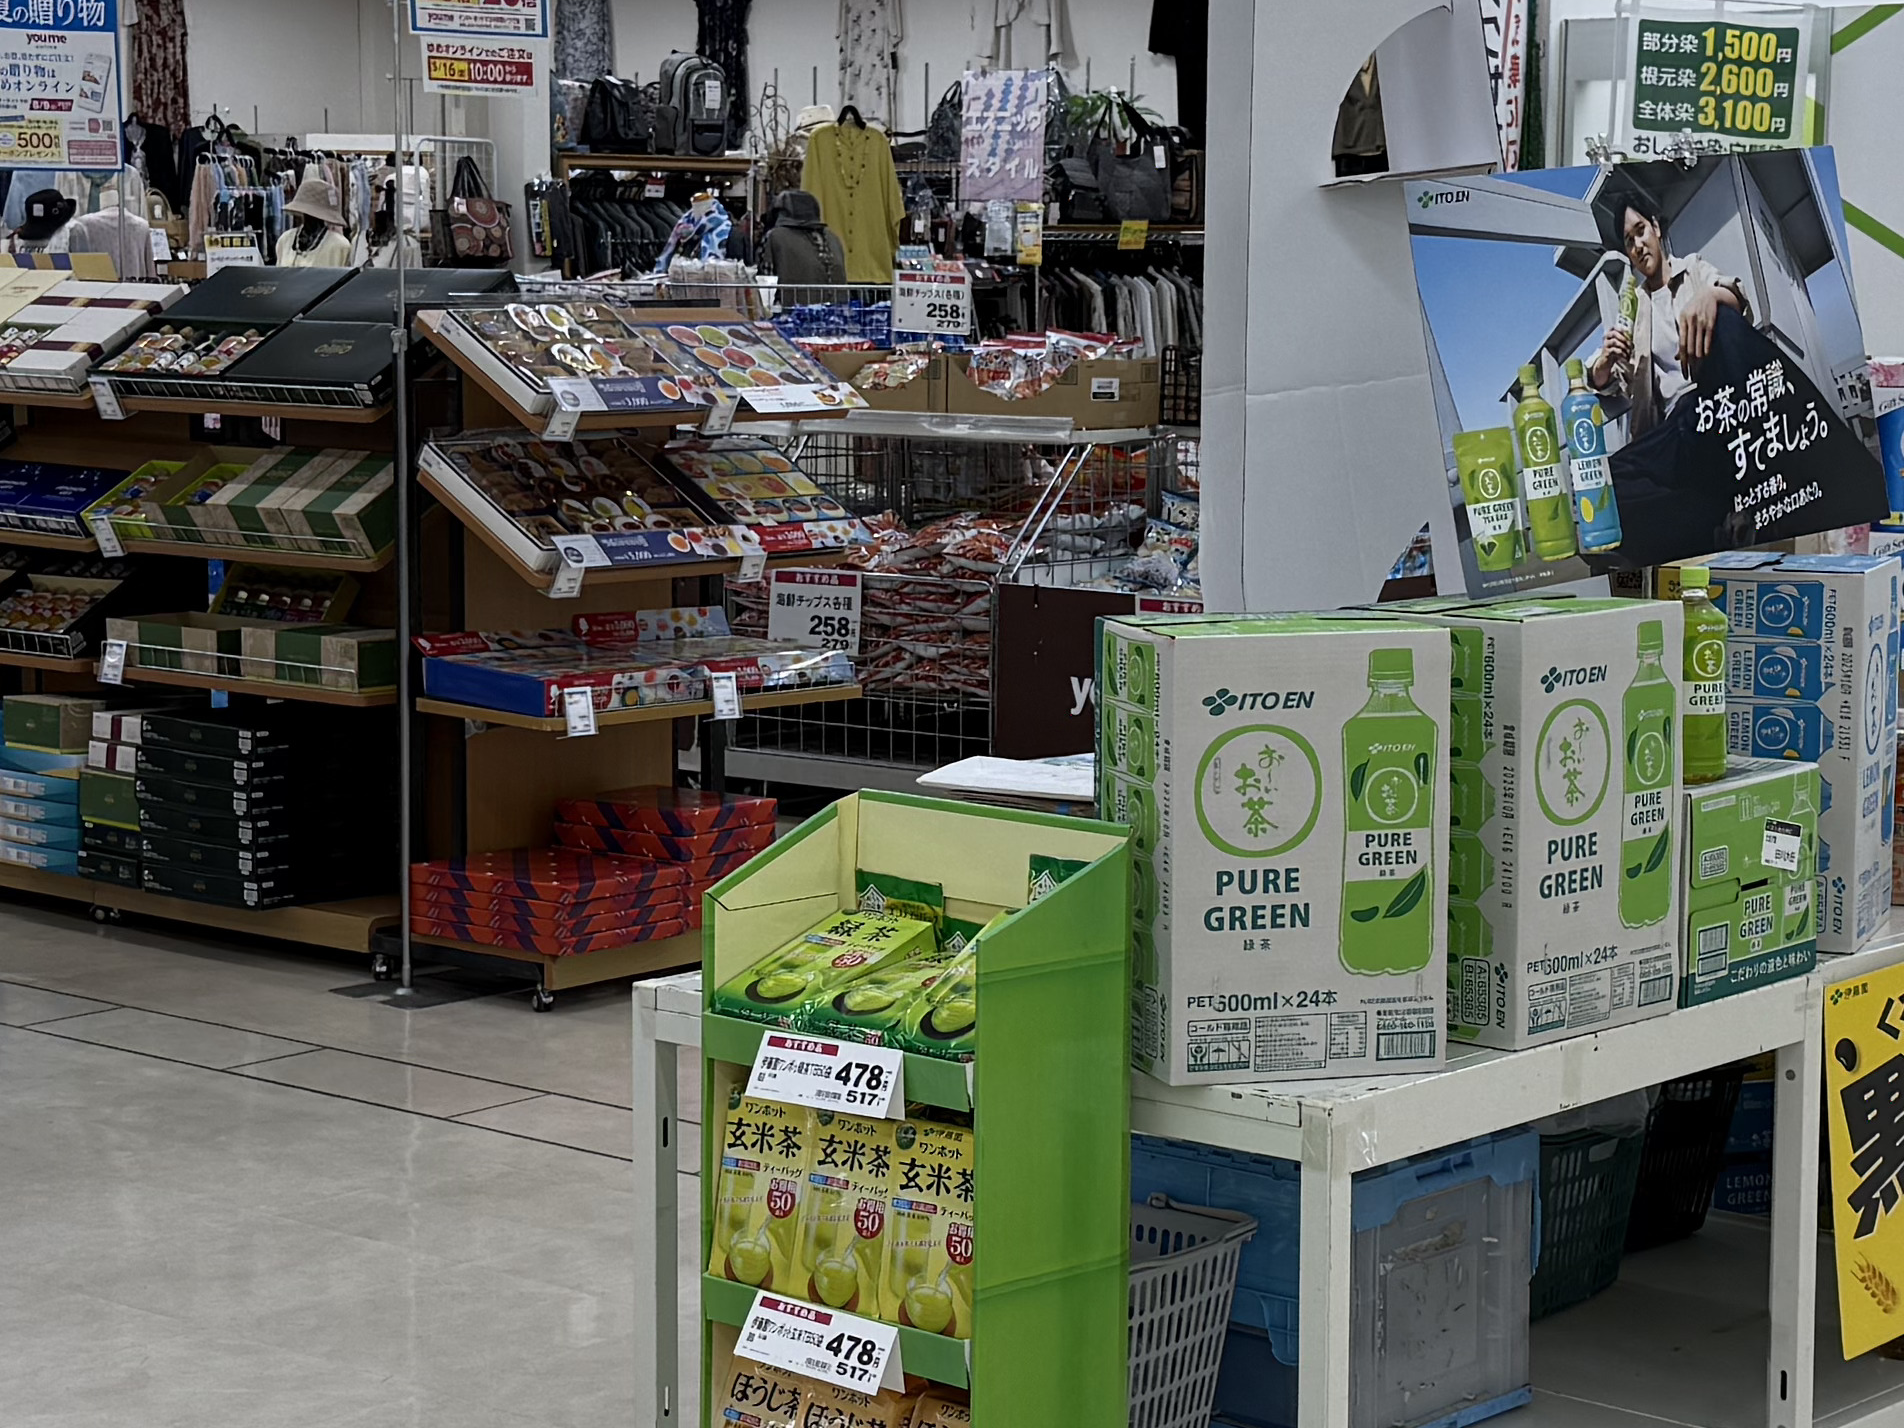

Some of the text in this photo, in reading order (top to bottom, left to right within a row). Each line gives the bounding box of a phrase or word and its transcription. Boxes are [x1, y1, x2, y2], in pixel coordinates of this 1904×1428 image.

[26, 33, 67, 45] youme
[1642, 26, 1792, 64] 部分染 1,500円
[469, 63, 504, 81] 10:00
[1640, 62, 1789, 98] 根元染 2,600円
[1638, 96, 1786, 134] 全体染 3,100円
[926, 303, 961, 318] 258
[1694, 360, 1796, 434] お茶の常識、
[1728, 403, 1829, 482] すてましょう。
[1732, 590, 1743, 630] GREEN
[1742, 588, 1755, 629] LEMON
[809, 614, 850, 638] 258
[1562, 669, 1587, 686] ITO
[1693, 682, 1724, 695] PURE
[1238, 690, 1314, 711] ITO EN
[1364, 832, 1412, 848] PURE
[1547, 833, 1598, 864] PURE
[1358, 850, 1417, 866] GREEN
[1215, 868, 1300, 896] PURE
[1539, 866, 1603, 900] GREEN
[1204, 902, 1311, 933] GREEN
[1744, 895, 1771, 915] PURE
[1740, 916, 1773, 938] GREEN
[835, 1062, 884, 1090] 478
[846, 1090, 878, 1106] 517
[727, 1117, 802, 1159] 玄米茶
[817, 1134, 891, 1178] 玄米茶
[899, 1158, 974, 1203] 玄米茶
[857, 1212, 879, 1232] 50
[949, 1238, 972, 1258] 50
[825, 1333, 877, 1366] 478
[836, 1362, 869, 1382] 517
